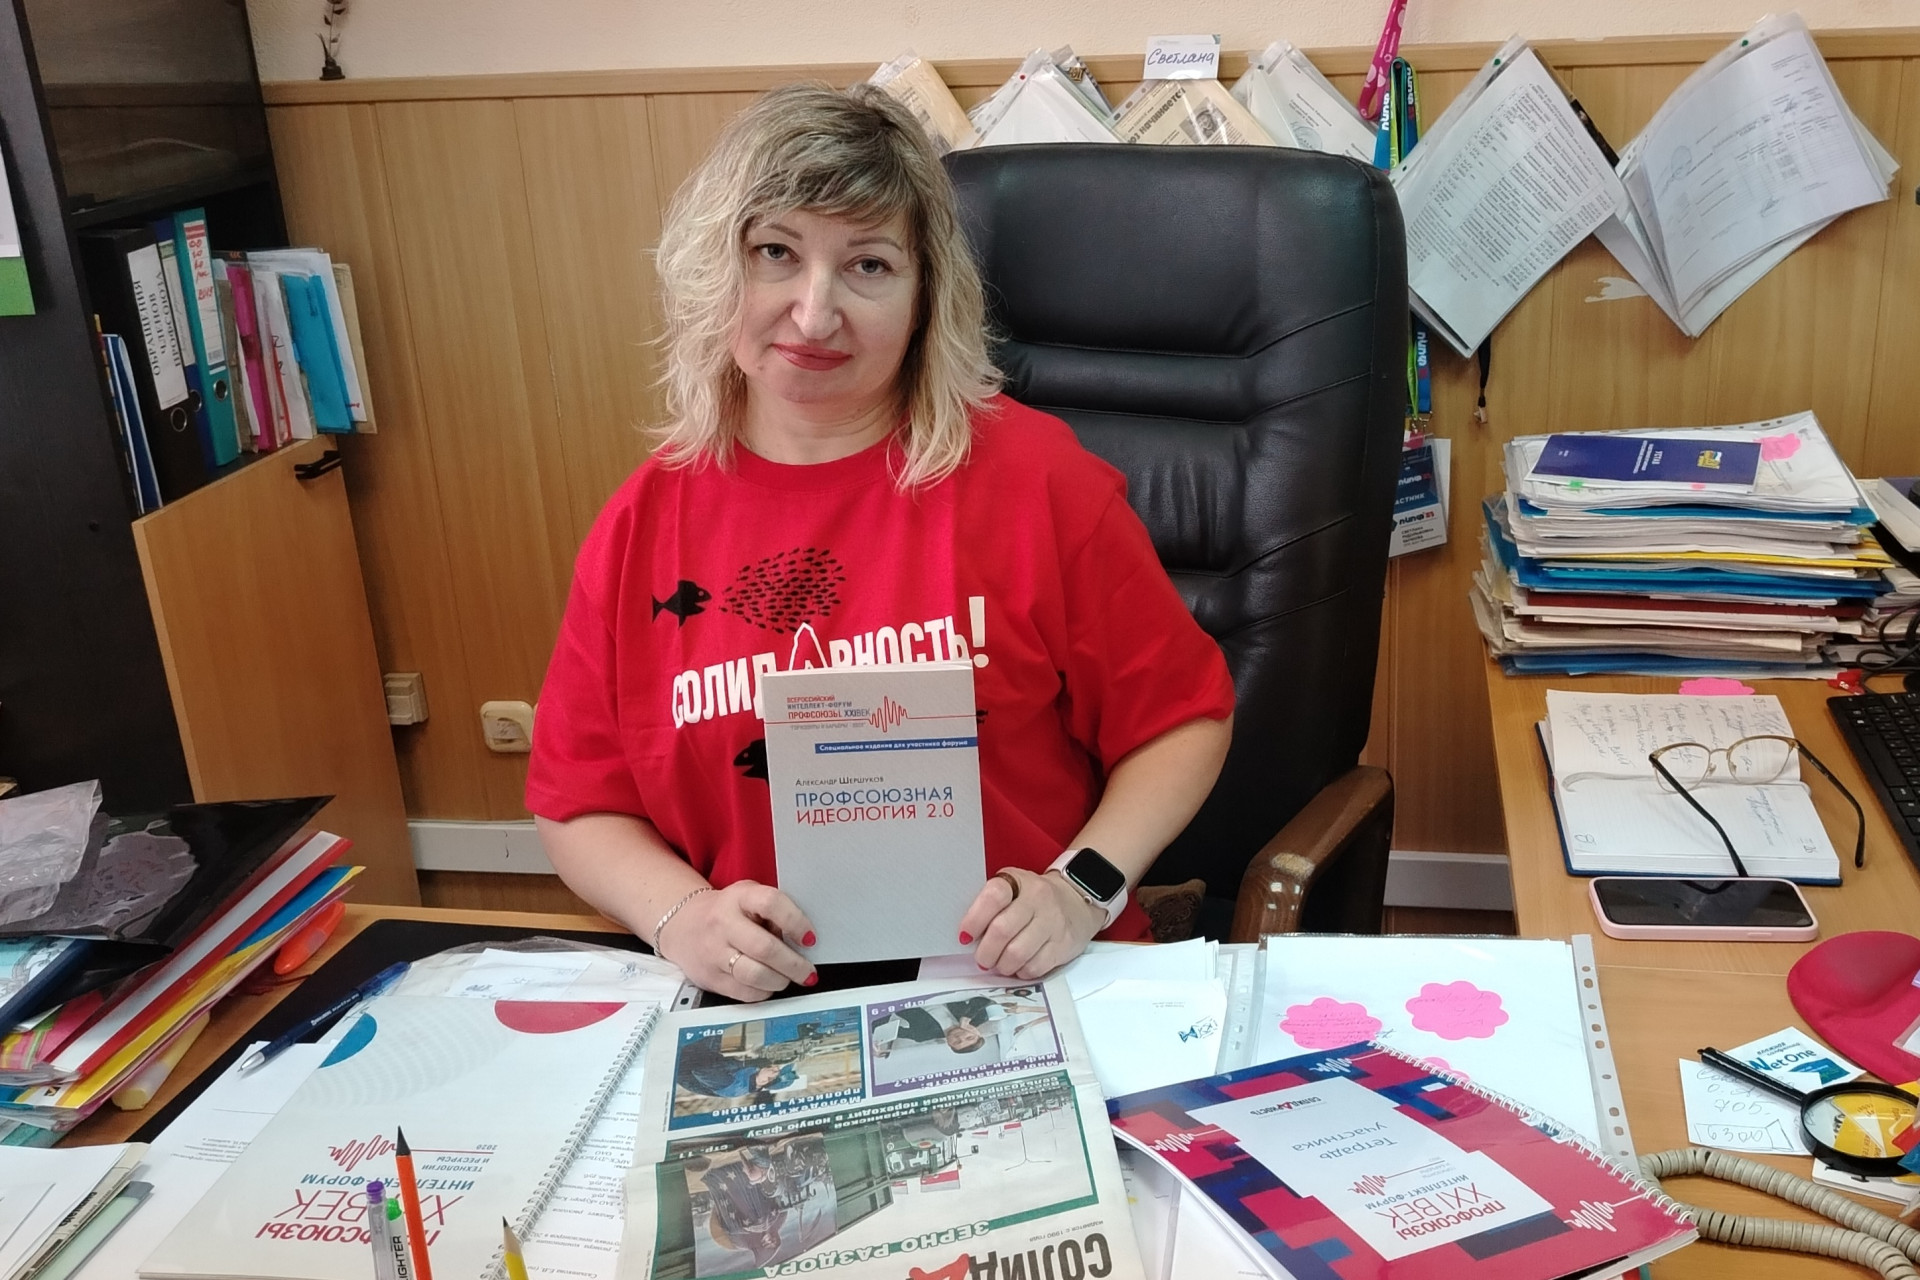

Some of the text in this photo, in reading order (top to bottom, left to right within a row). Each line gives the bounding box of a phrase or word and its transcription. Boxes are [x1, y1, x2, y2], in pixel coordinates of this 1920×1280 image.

[1147, 48, 1215, 66] Светлана
[133, 279, 162, 377] ОБРАЩЕНИЯ
[149, 293, 166, 355] ЧЛЕНОВ
[156, 271, 181, 368] ПРОФСОЮЗА
[787, 695, 835, 703] ВСЕРОССИЙСКИЙ
[787, 701, 852, 710] ИНТЕЛЛЕКТ-ФОРУМ
[788, 710, 841, 719] ПРОФСОЮЗЫ
[819, 742, 864, 751] Специальное
[865, 742, 893, 750] издание
[893, 742, 905, 750] для
[942, 739, 968, 748] форума
[795, 786, 953, 807] ПРОФСОЮЗНАЯ
[796, 803, 954, 826] ИДЕОЛОГИЯ 2.0
[899, 999, 926, 1009] стр.
[685, 1028, 724, 1040] стр. 4
[993, 1059, 1019, 1069] или
[894, 1063, 992, 1088] реальность?
[920, 1060, 1059, 1089] Многозадачность:
[788, 1087, 860, 1106] прописку
[923, 1077, 1058, 1106] сельхозпродукцией
[712, 1103, 765, 1117] законе
[723, 1096, 860, 1125] Молодежи дадут
[847, 1102, 918, 1119] переходит
[1250, 1096, 1322, 1115] СОЛИДАРНОСТЬ
[787, 1117, 830, 1130] новую
[834, 1109, 915, 1129] украинской
[747, 1125, 783, 1138] фазу
[1291, 1122, 1387, 1152] участника
[679, 1144, 728, 1159] стр. 11
[1319, 1136, 1398, 1160] Тетрадь
[421, 1164, 483, 1173] ТЕХНОЛОГИИ
[1365, 1174, 1469, 1210] ИНТЕЛЛЕКТ-ФОРУМ
[274, 1189, 367, 1223] ВЕК
[1375, 1197, 1442, 1229] ВЕК
[1071, 1220, 1104, 1231] издается
[1396, 1200, 1506, 1240] ПРОФСОЮЗЫ
[1029, 1233, 1046, 1242] года
[1047, 1229, 1065, 1239] 1990
[392, 1235, 408, 1280] IGHTER
[763, 1220, 990, 1278] ЗЕРНО РАЗДОРА
